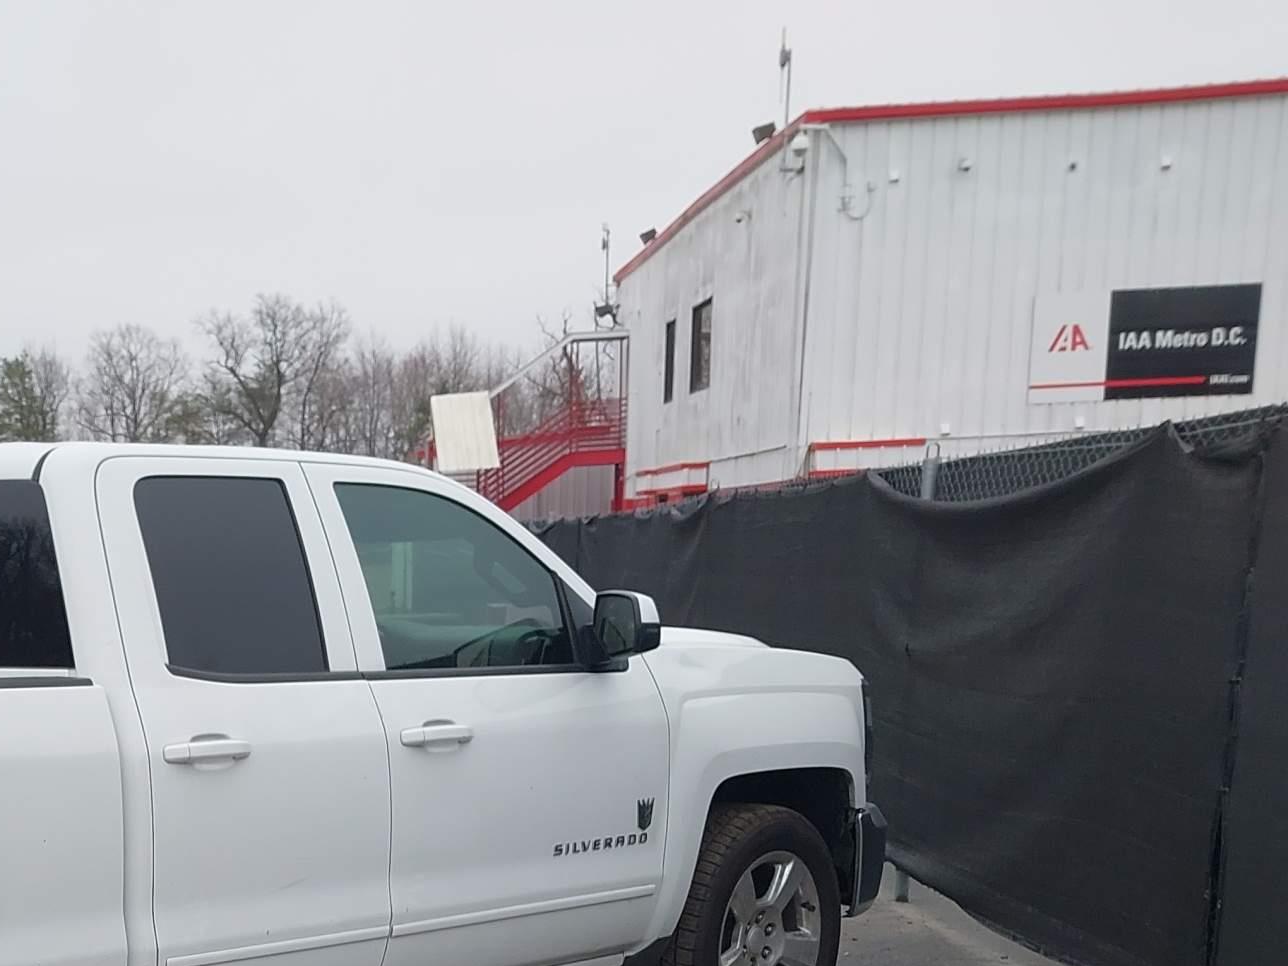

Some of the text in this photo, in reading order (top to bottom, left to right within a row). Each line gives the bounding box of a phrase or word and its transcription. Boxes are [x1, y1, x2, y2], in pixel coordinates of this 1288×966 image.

[1118, 325, 1247, 351] IAA Metro D.C.
[553, 832, 648, 857] SILVERADO
